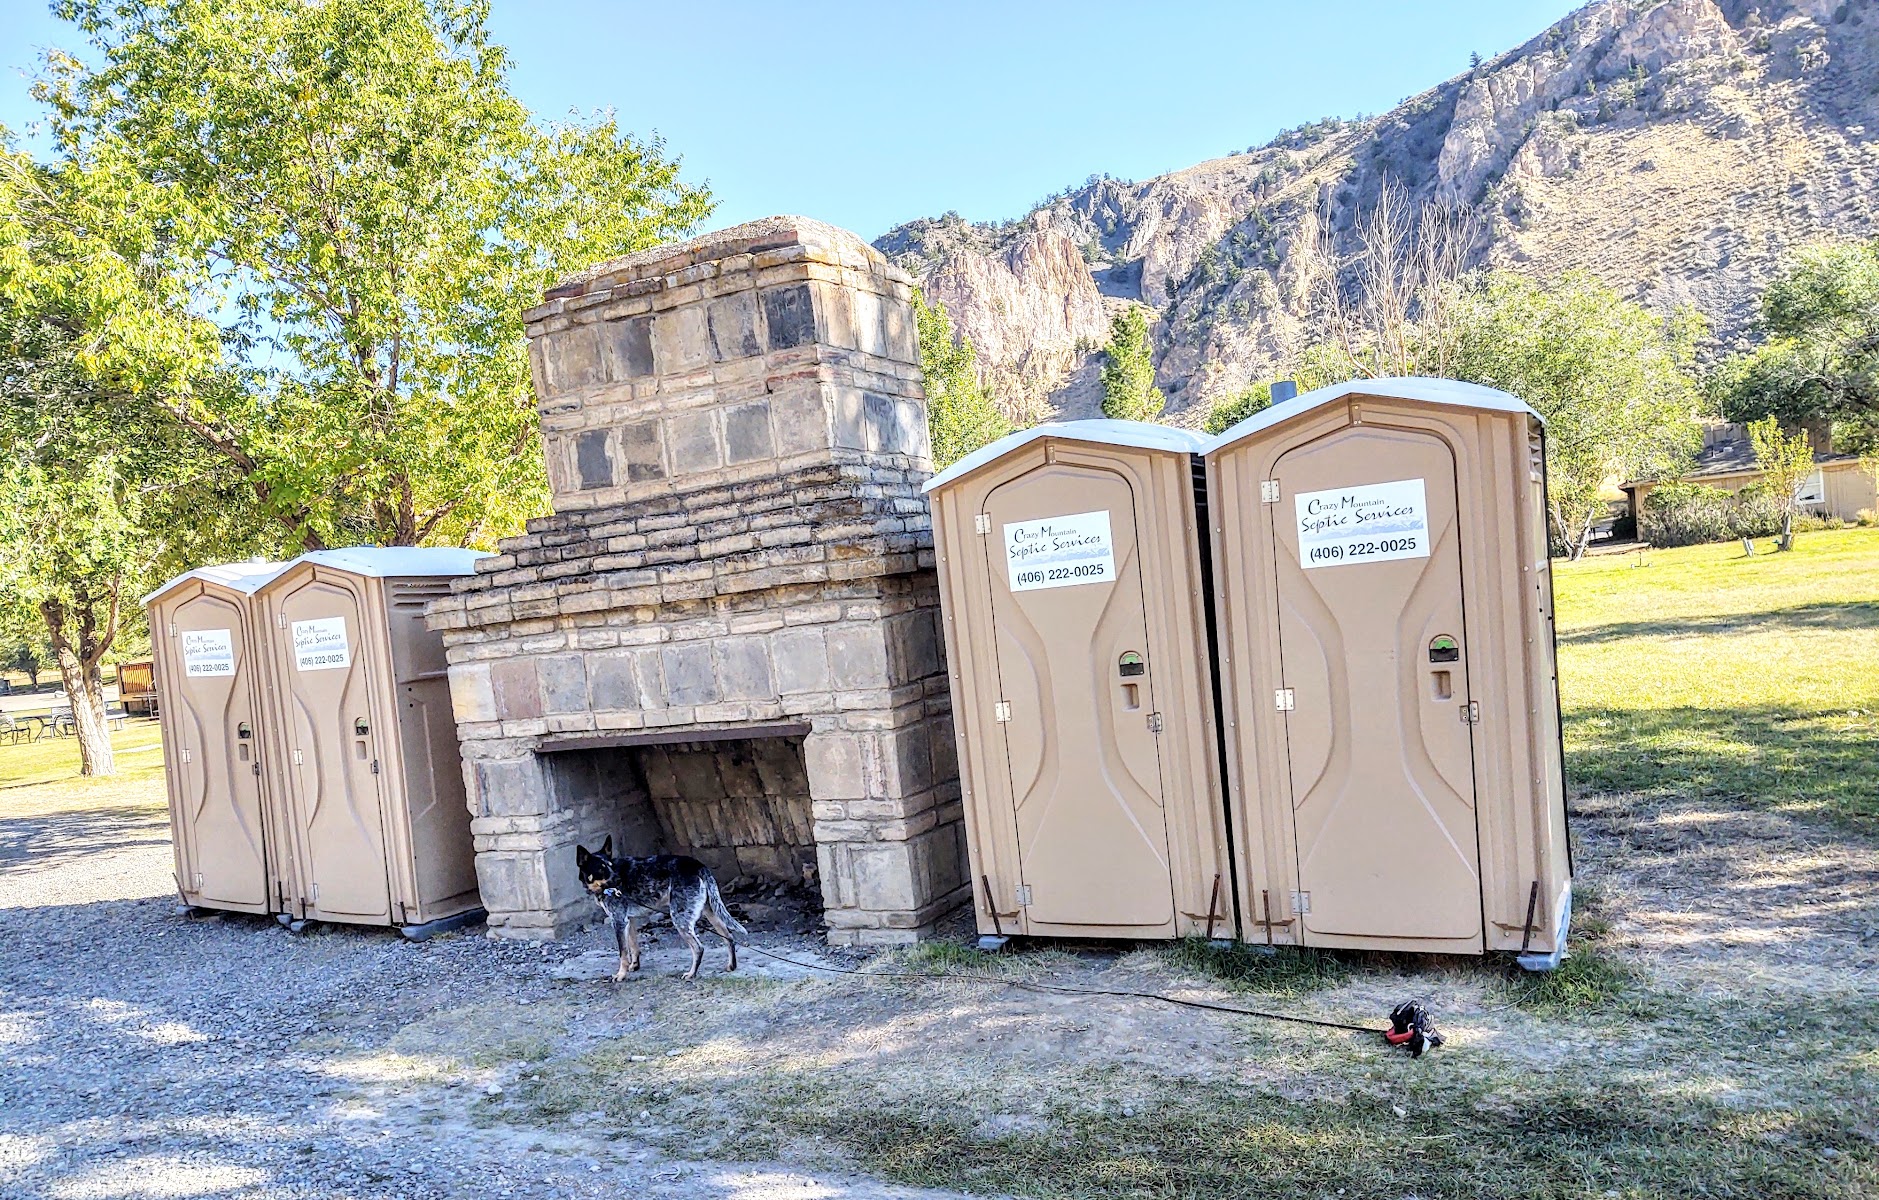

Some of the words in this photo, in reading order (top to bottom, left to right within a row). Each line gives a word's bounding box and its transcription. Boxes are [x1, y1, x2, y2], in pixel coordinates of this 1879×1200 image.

[1308, 499, 1339, 515] Crazy
[1342, 496, 1385, 509] Mountain
[1302, 515, 1348, 533] Septic
[1355, 506, 1414, 524] Services
[1015, 529, 1039, 543] Crazy
[1042, 526, 1076, 538] Mountain
[1010, 543, 1047, 560] Septic
[1053, 535, 1101, 551] Services
[1310, 545, 1344, 563] (406)
[1349, 538, 1416, 556] 222-0025
[1017, 571, 1044, 586] (406)
[1049, 564, 1104, 580] 222-0025
[315, 654, 344, 664] 222-0025
